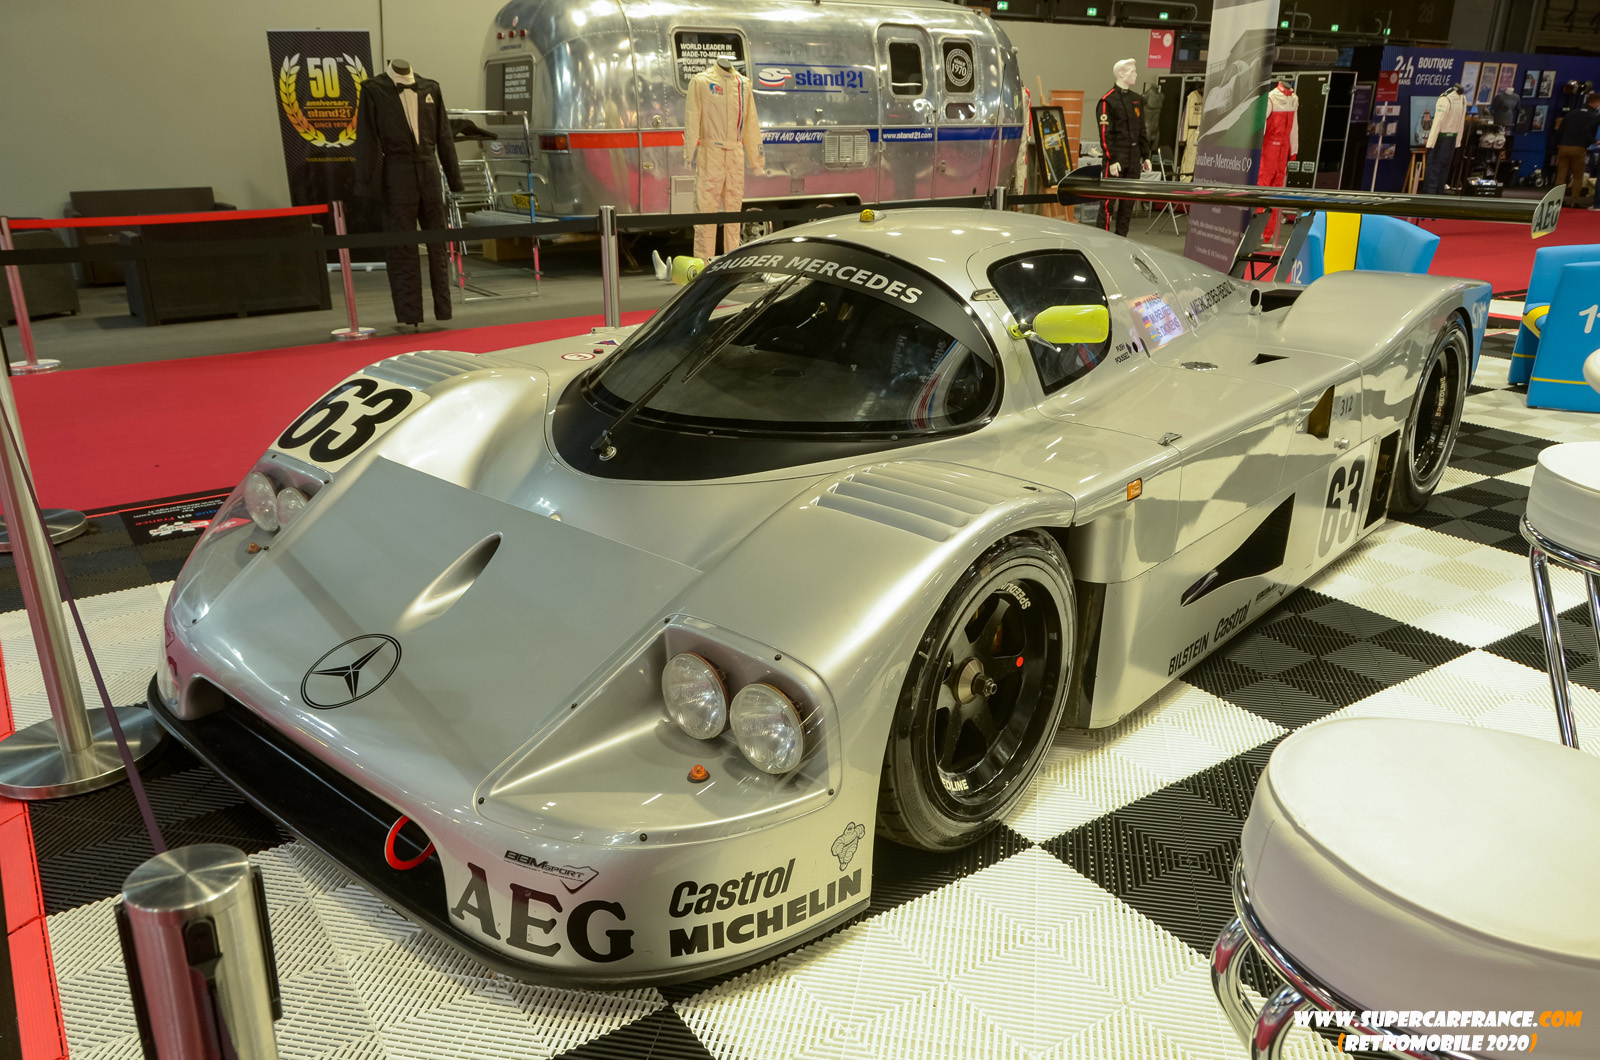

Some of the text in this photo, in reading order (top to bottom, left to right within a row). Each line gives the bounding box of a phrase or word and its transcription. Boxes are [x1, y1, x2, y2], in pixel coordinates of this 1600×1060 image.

[680, 43, 702, 51] WORLD
[951, 63, 967, 77] 1970
[1418, 57, 1454, 72] BOUTIQUE
[306, 56, 341, 98] 50
[795, 69, 864, 89] stand21
[1415, 74, 1451, 86] OFFICIELLE
[307, 108, 351, 118] stand21
[780, 131, 795, 142] AND
[882, 132, 933, 140] www.stand21.com
[1196, 152, 1253, 173] auber-Mercedes C9
[1533, 198, 1562, 233] AEG
[706, 254, 923, 305] SAUBER MERCEDES
[277, 377, 414, 463] 63
[1317, 454, 1366, 559] 63
[135, 516, 175, 526] France
[1213, 598, 1252, 643] Castrol
[1167, 631, 1210, 677] BILSTEIN
[941, 778, 969, 792] EDLINE
[668, 858, 797, 919] Castrol
[450, 861, 636, 964] AEG
[668, 868, 863, 958] MICHELIN
